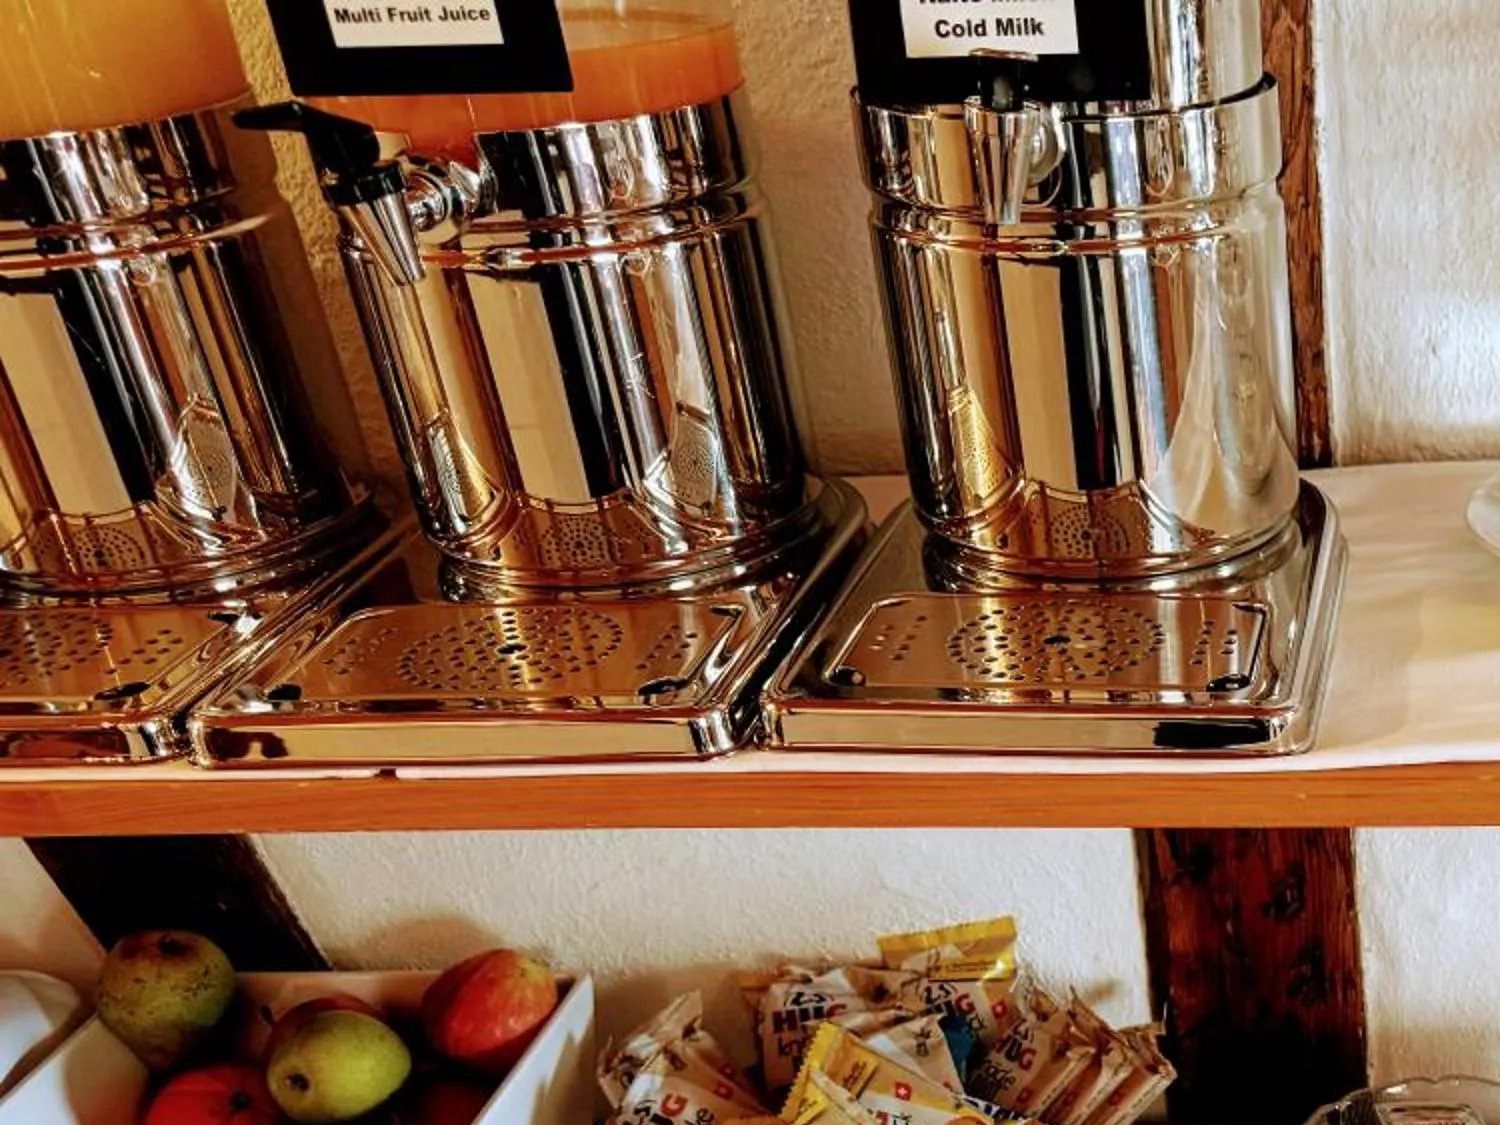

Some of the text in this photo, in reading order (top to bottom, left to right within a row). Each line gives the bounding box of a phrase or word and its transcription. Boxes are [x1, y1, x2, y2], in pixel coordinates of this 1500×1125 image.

[334, 6, 490, 24] Multi Fruit Juice
[934, 17, 1043, 38] Cold Milk
